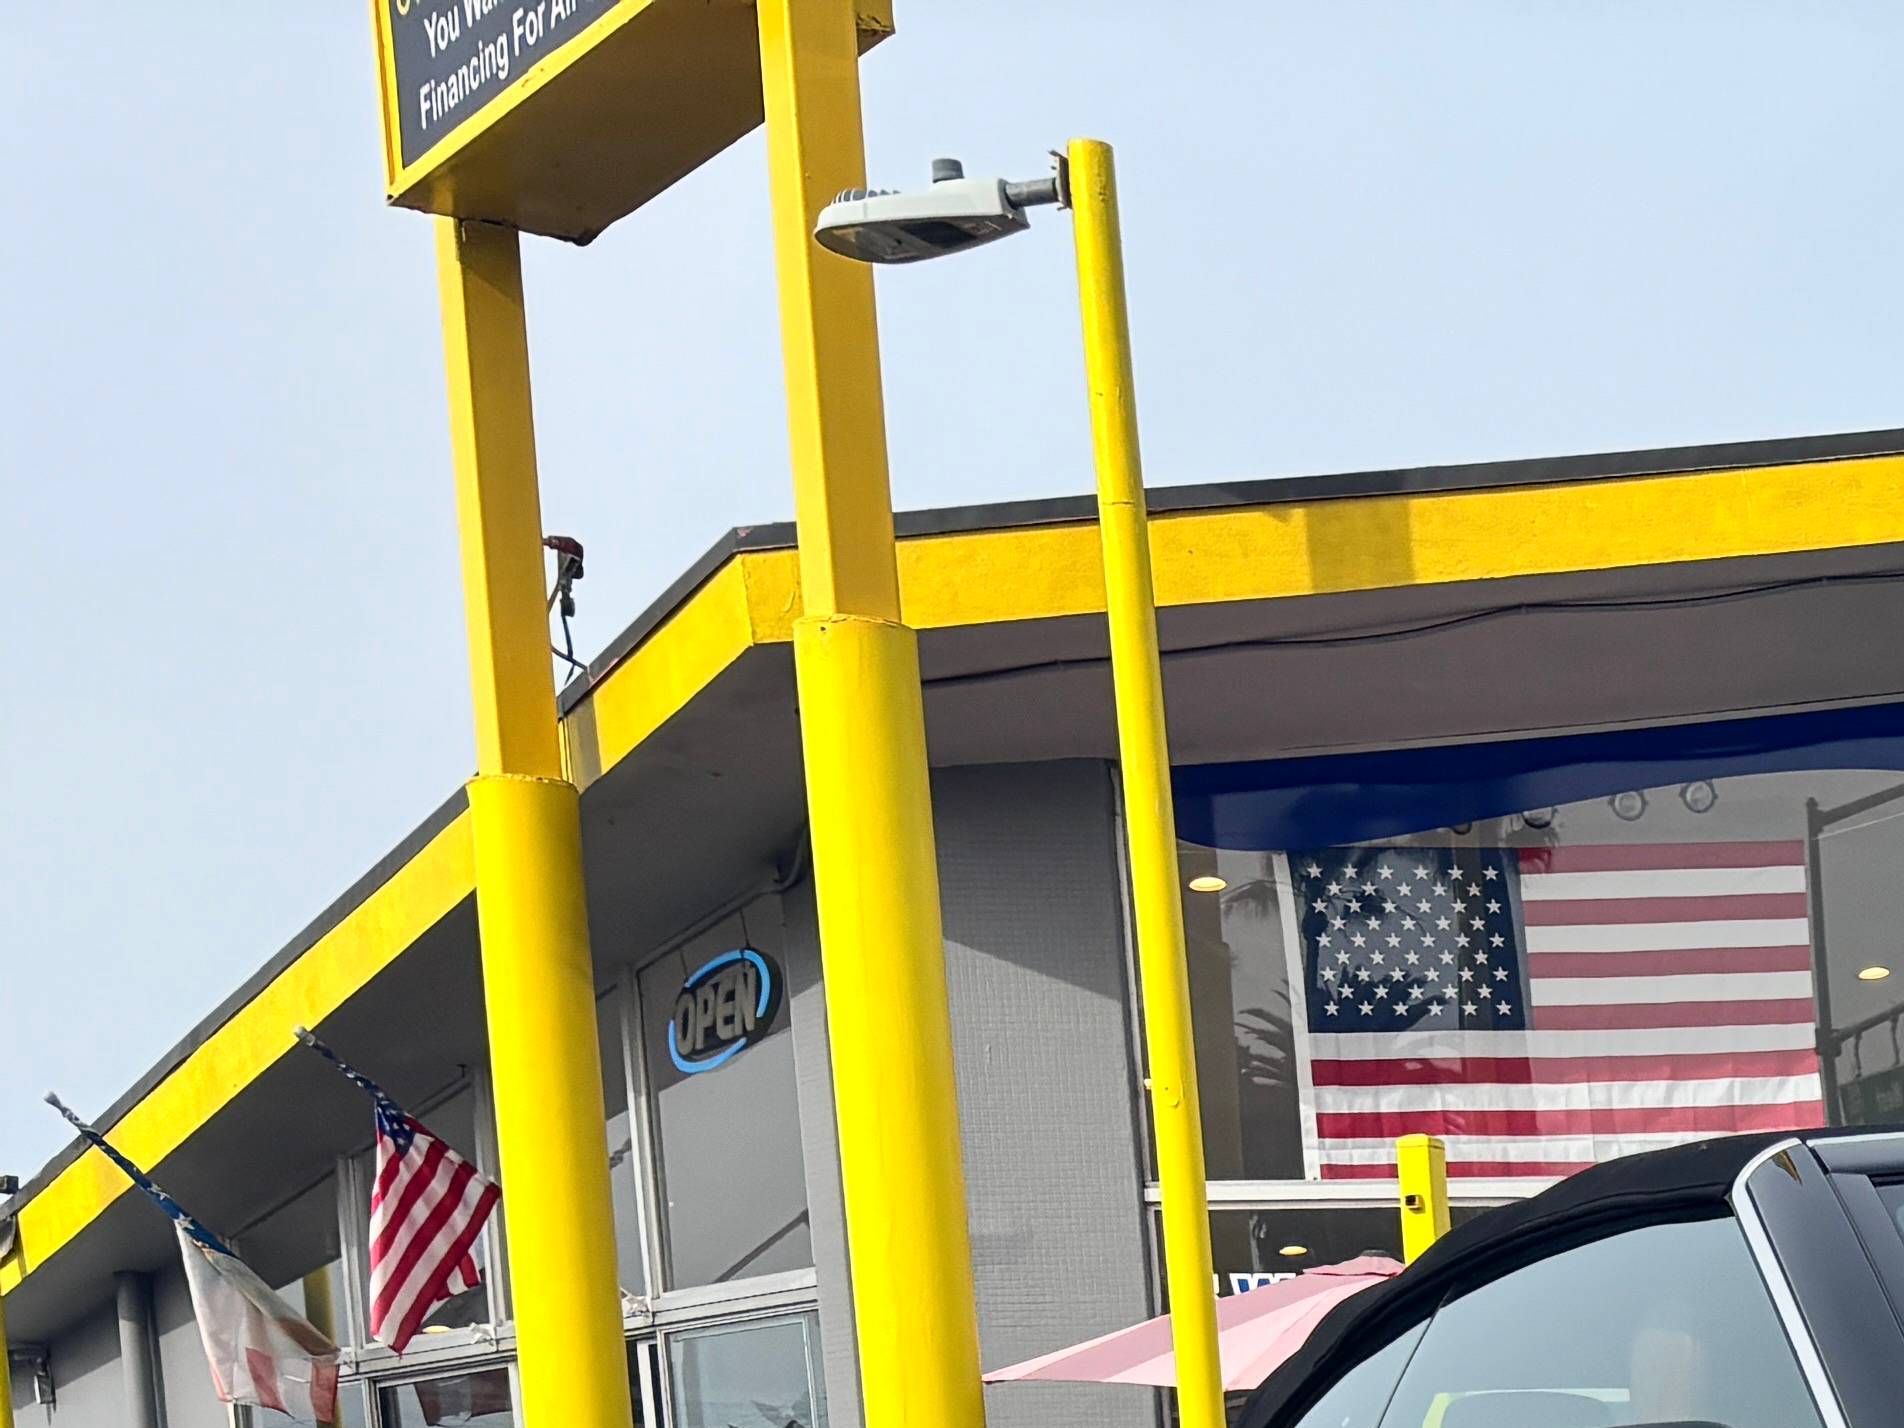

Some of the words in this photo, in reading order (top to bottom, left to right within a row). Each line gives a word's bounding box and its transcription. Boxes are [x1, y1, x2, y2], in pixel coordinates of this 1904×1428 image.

[420, 33, 509, 130] Financing
[512, 8, 547, 57] For
[424, 6, 460, 58] You
[676, 965, 756, 1056] OPEN
